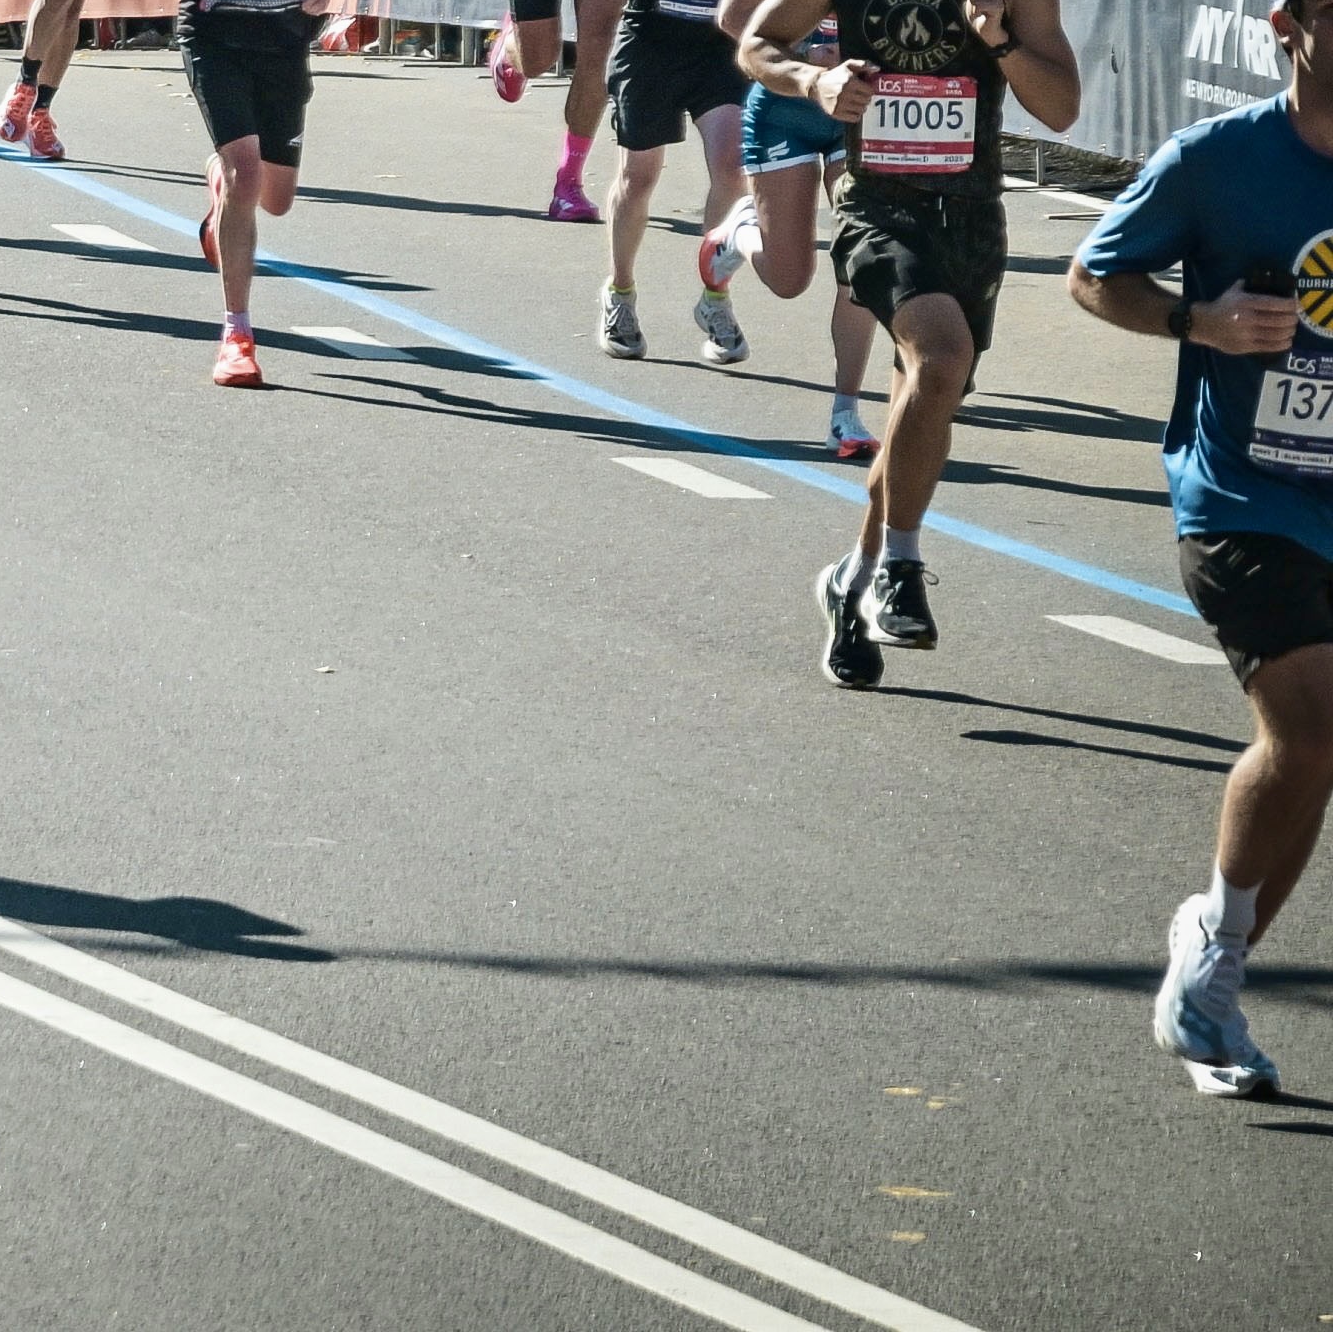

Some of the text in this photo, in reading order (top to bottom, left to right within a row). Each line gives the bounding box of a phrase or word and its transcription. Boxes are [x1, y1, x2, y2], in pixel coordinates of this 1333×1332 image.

[873, 37, 958, 71] BURNERS
[878, 77, 902, 93] tcs
[874, 98, 964, 130] 11005
[1287, 352, 1317, 375] tcs
